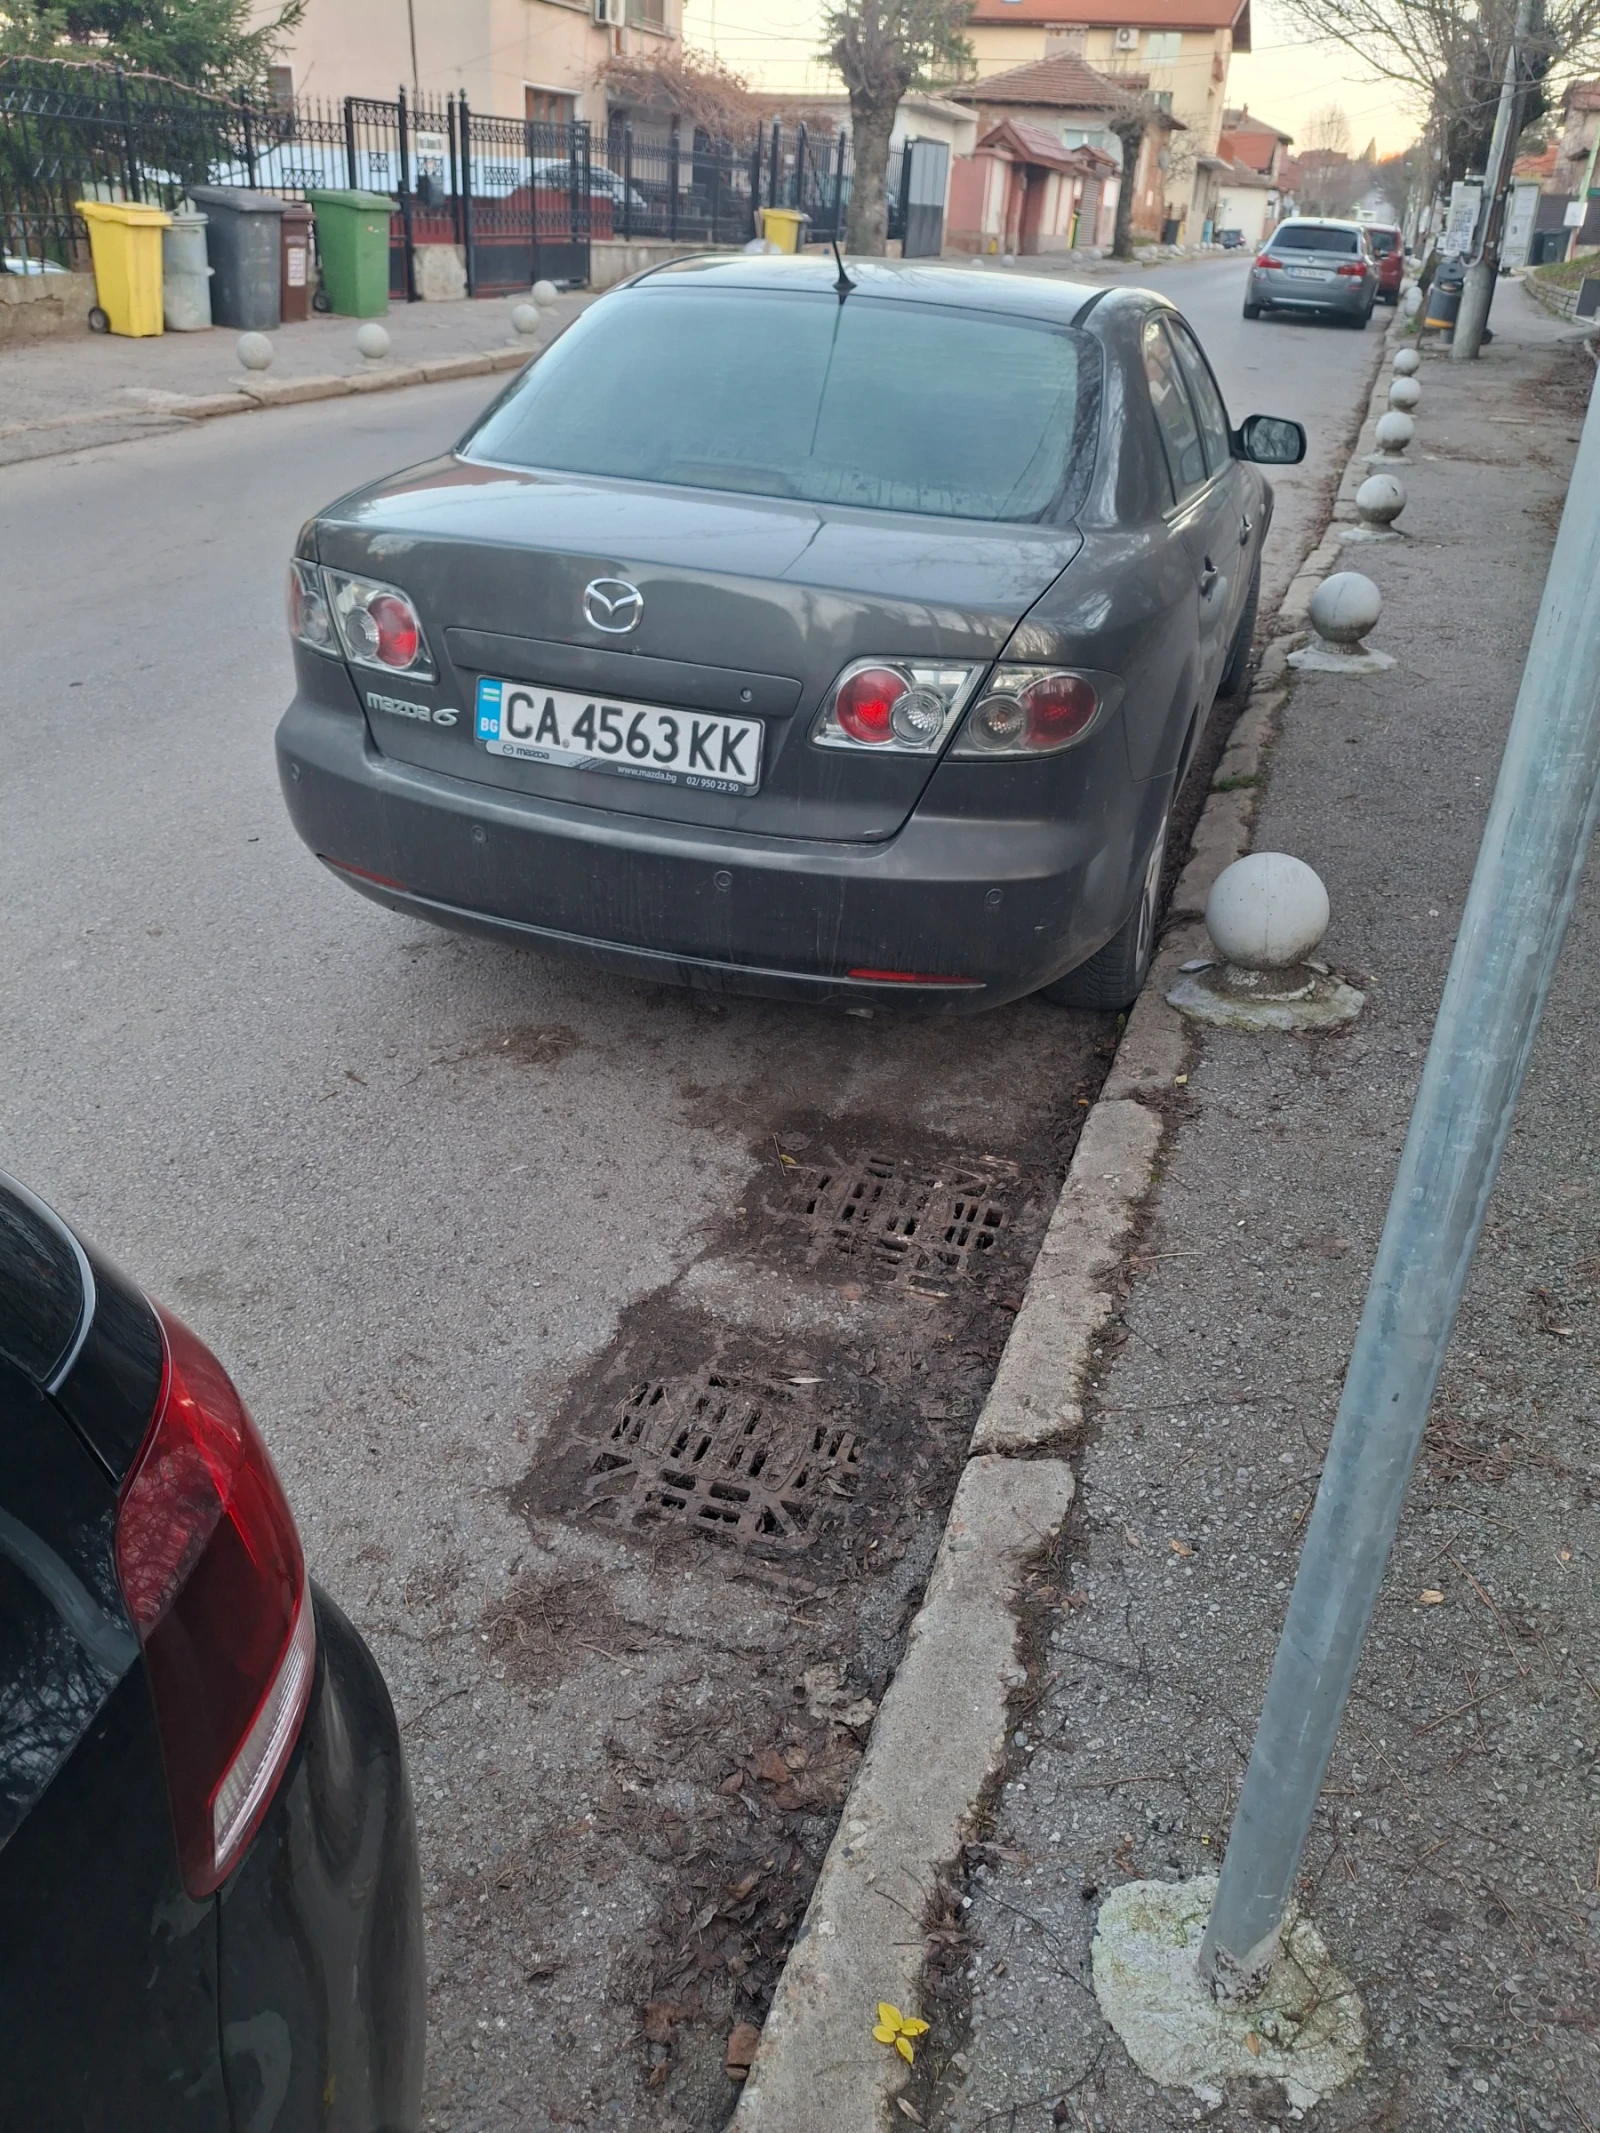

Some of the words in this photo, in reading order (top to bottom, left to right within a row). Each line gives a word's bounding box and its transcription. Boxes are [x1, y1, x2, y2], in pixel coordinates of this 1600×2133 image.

[432, 708, 460, 726] 6
[480, 717, 498, 733] BG
[505, 691, 561, 745] CA
[571, 704, 680, 763] 4563
[689, 720, 750, 776] KK
[516, 747, 550, 760] mazda
[617, 765, 677, 783] www.mazda.bg
[701, 778, 715, 789] 950
[716, 781, 728, 791] 22
[728, 783, 739, 792] 50
